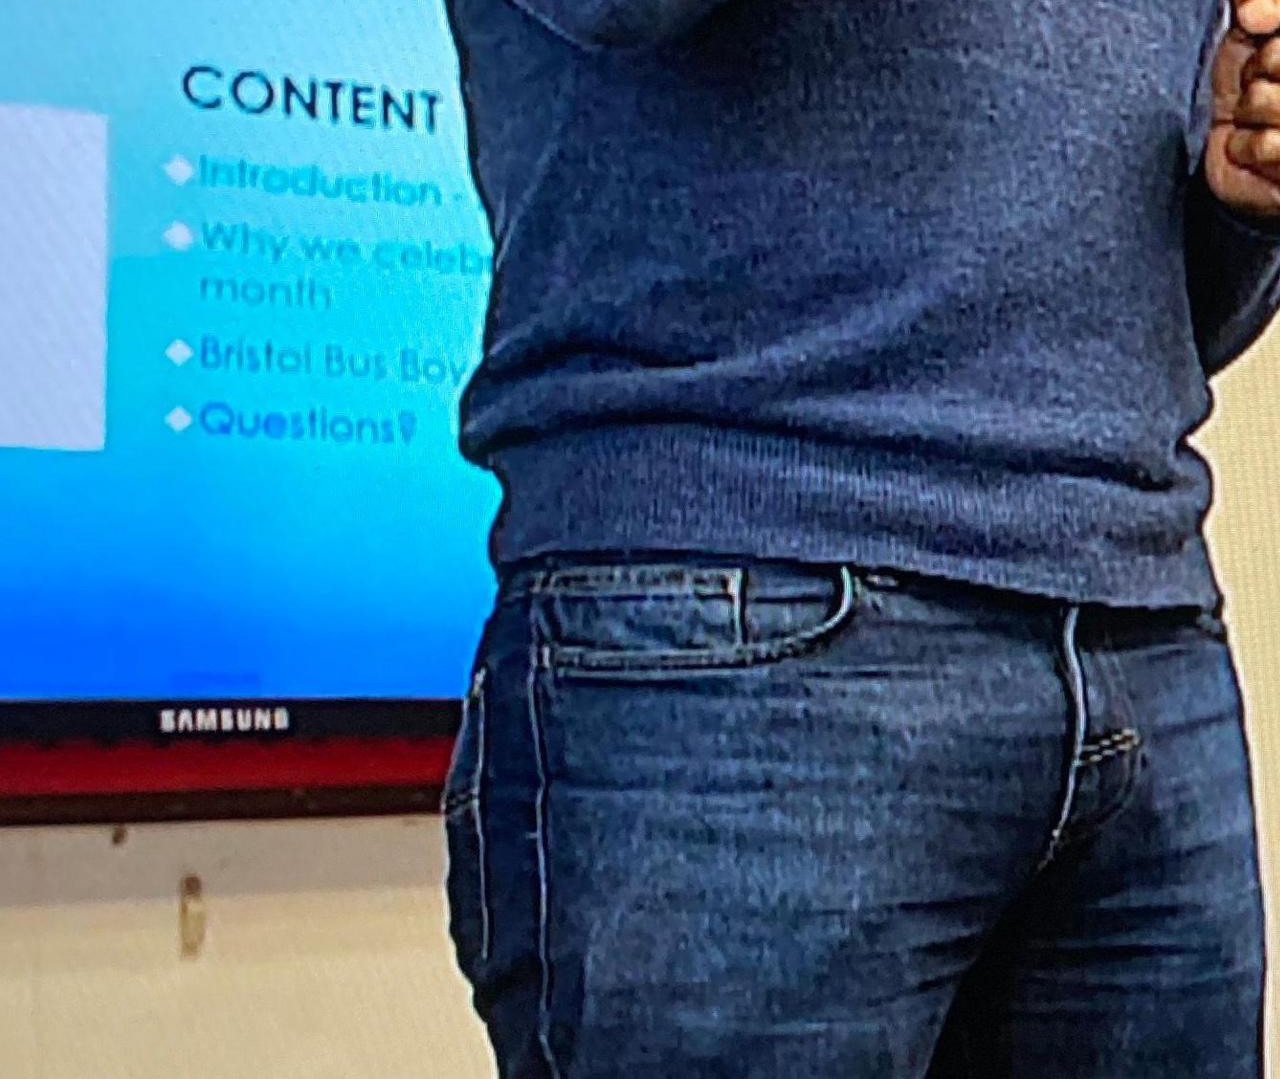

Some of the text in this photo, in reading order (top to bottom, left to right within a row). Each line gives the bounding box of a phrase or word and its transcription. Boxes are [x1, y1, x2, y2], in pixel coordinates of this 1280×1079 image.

[183, 66, 441, 133] CONTENT
[199, 155, 442, 206] Introduction
[202, 222, 290, 264] Why
[301, 236, 362, 264] we
[201, 275, 332, 308] month
[201, 336, 313, 375] Bristol
[324, 344, 387, 380] Bus
[200, 401, 417, 445] Questions?
[160, 707, 289, 733] SAMSUNG
